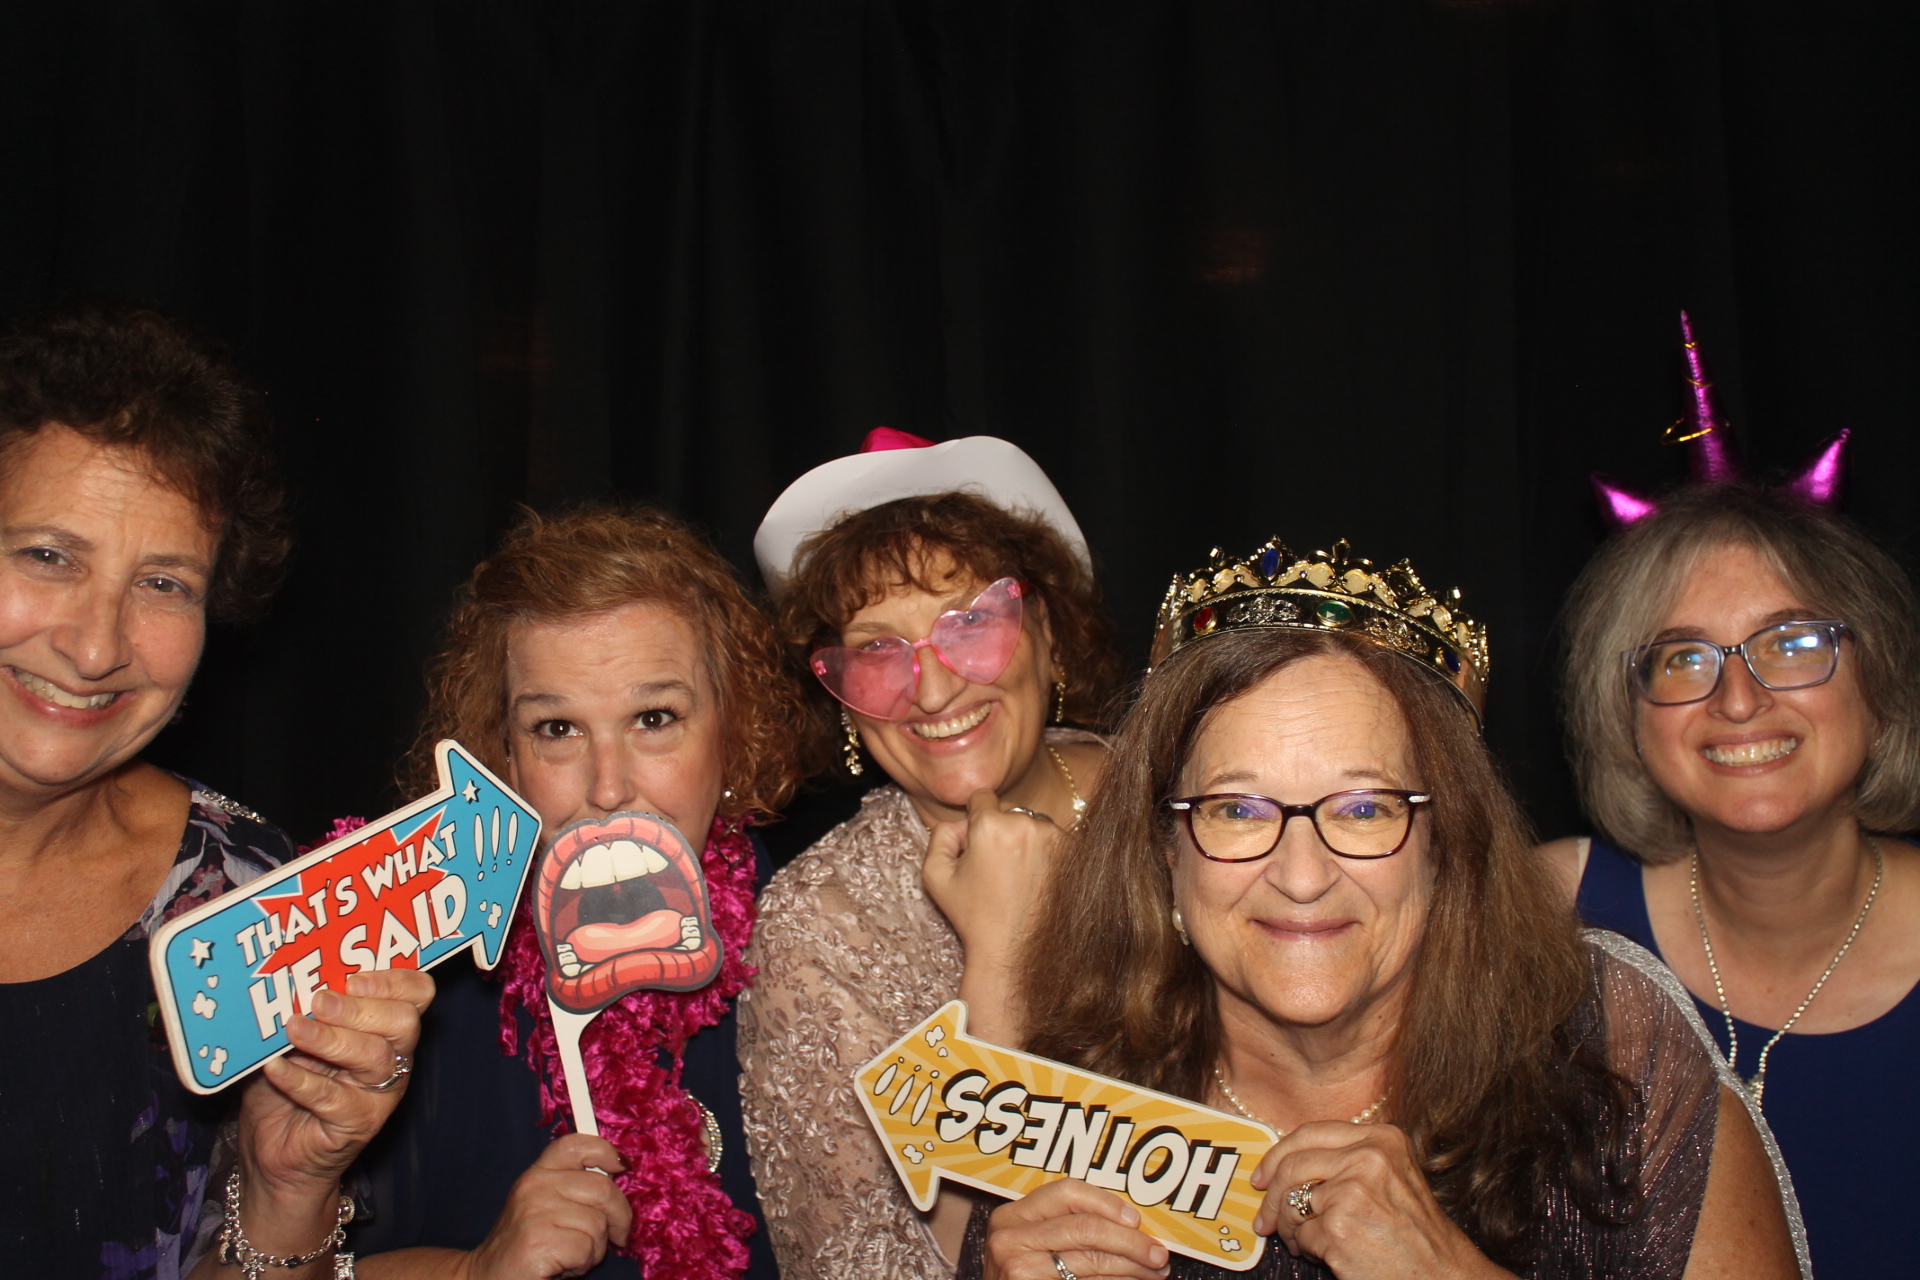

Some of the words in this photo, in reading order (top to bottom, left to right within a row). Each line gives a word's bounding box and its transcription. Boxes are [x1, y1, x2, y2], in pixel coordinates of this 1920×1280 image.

[236, 875, 358, 967] THAT'S
[361, 821, 457, 900] WHAT
[247, 949, 329, 1041] HE
[338, 873, 468, 976] SAID
[935, 1068, 1241, 1221] HOTNESS
